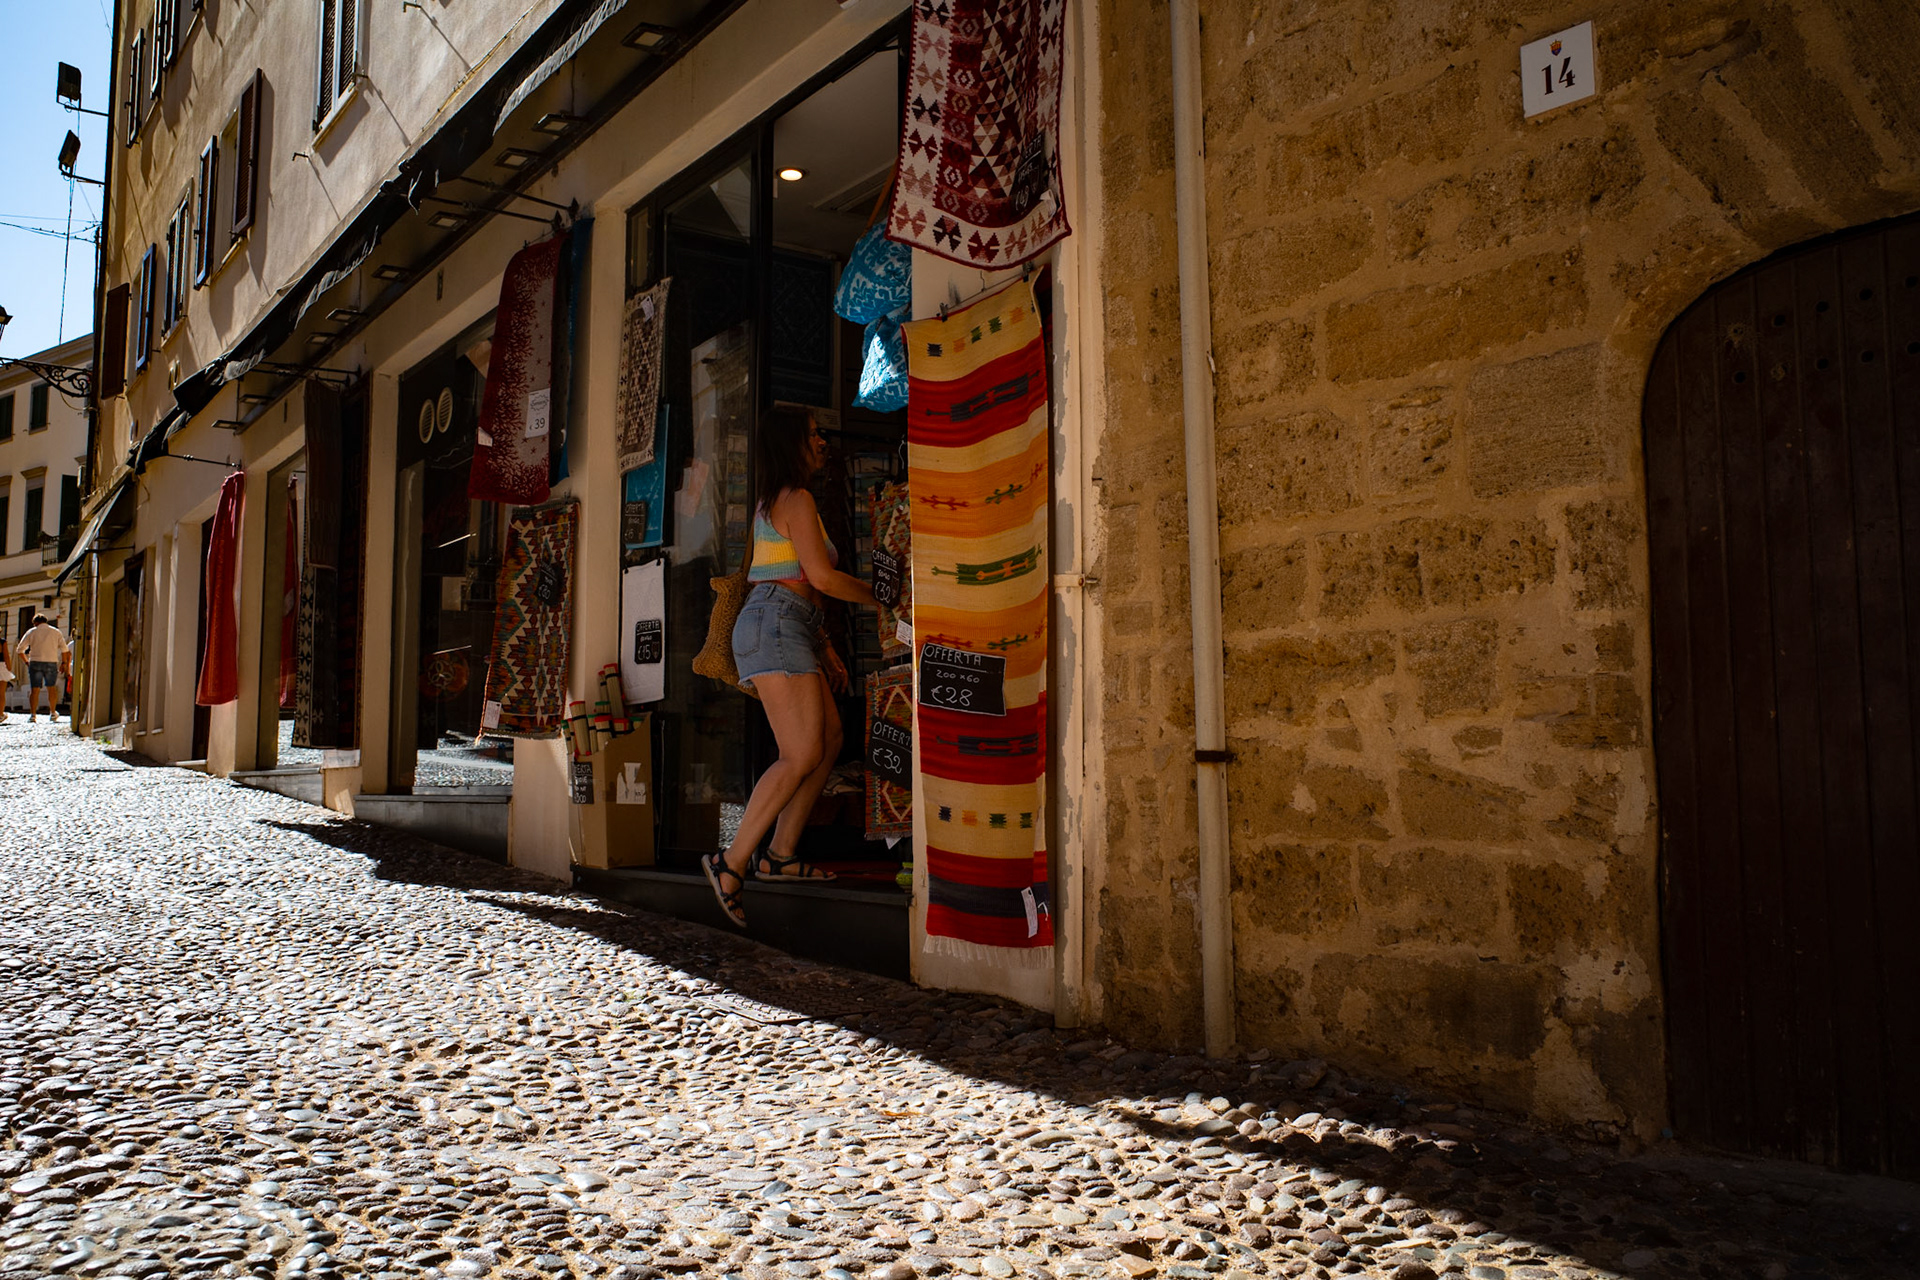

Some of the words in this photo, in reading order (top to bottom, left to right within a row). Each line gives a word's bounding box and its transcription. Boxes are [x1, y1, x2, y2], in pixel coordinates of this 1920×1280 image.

[1541, 56, 1576, 95] 14
[534, 417, 546, 430] 39
[872, 549, 898, 569] OFFERTA
[875, 581, 892, 604] €32
[636, 620, 660, 632] OFFERTA
[924, 645, 983, 667] OFFERTA
[936, 669, 957, 679] 200
[931, 685, 974, 707] €28
[873, 721, 912, 748] OFFERT
[872, 748, 902, 774] €32
